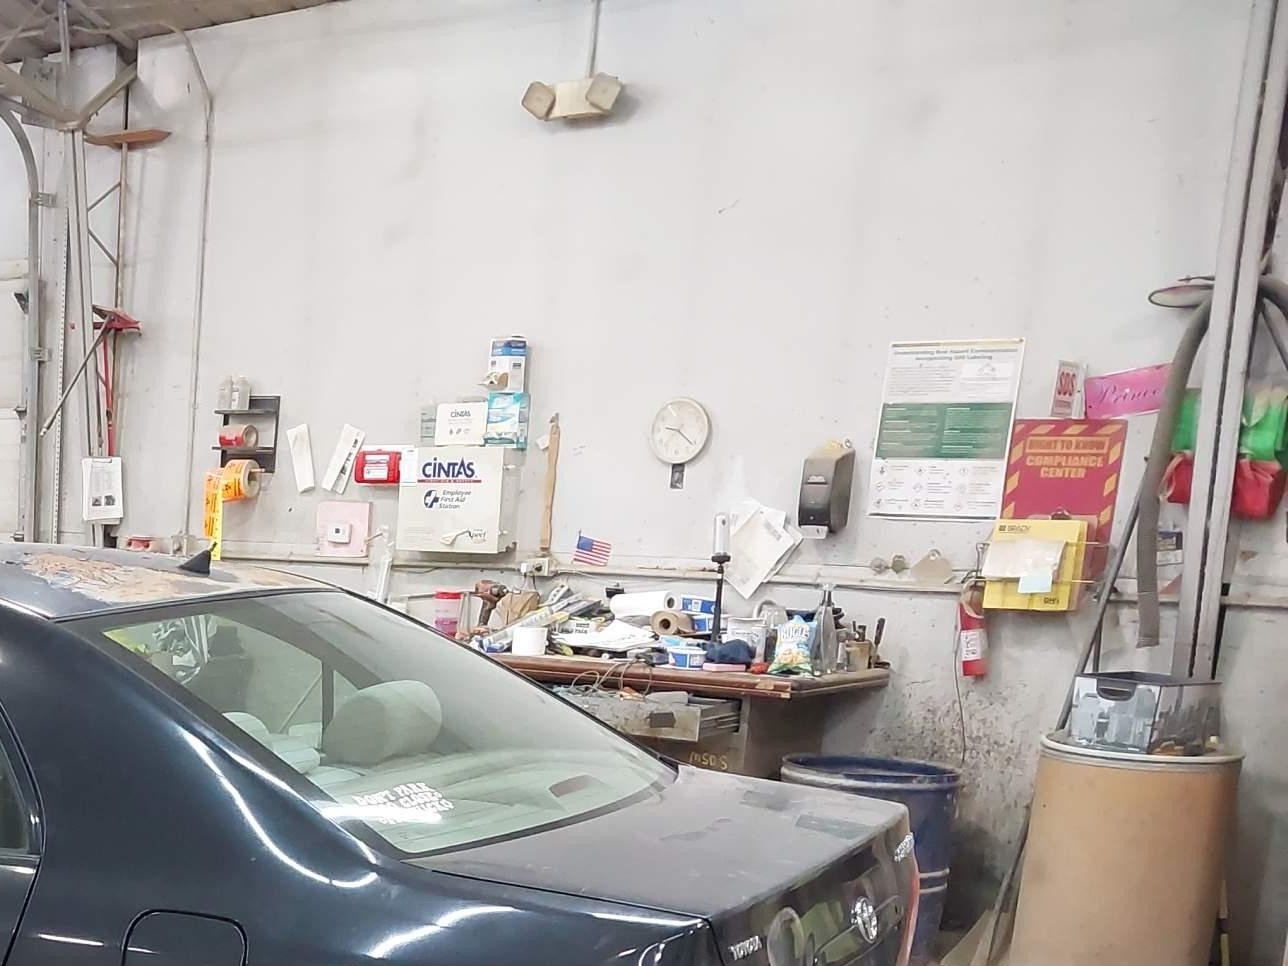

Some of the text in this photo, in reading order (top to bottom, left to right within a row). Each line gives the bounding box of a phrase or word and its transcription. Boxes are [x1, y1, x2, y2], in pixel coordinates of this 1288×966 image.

[1025, 455, 1105, 468] COMPLIANCE
[1039, 467, 1087, 478] CENTER
[393, 782, 436, 799] PARK
[728, 935, 762, 960] TOYOTA
